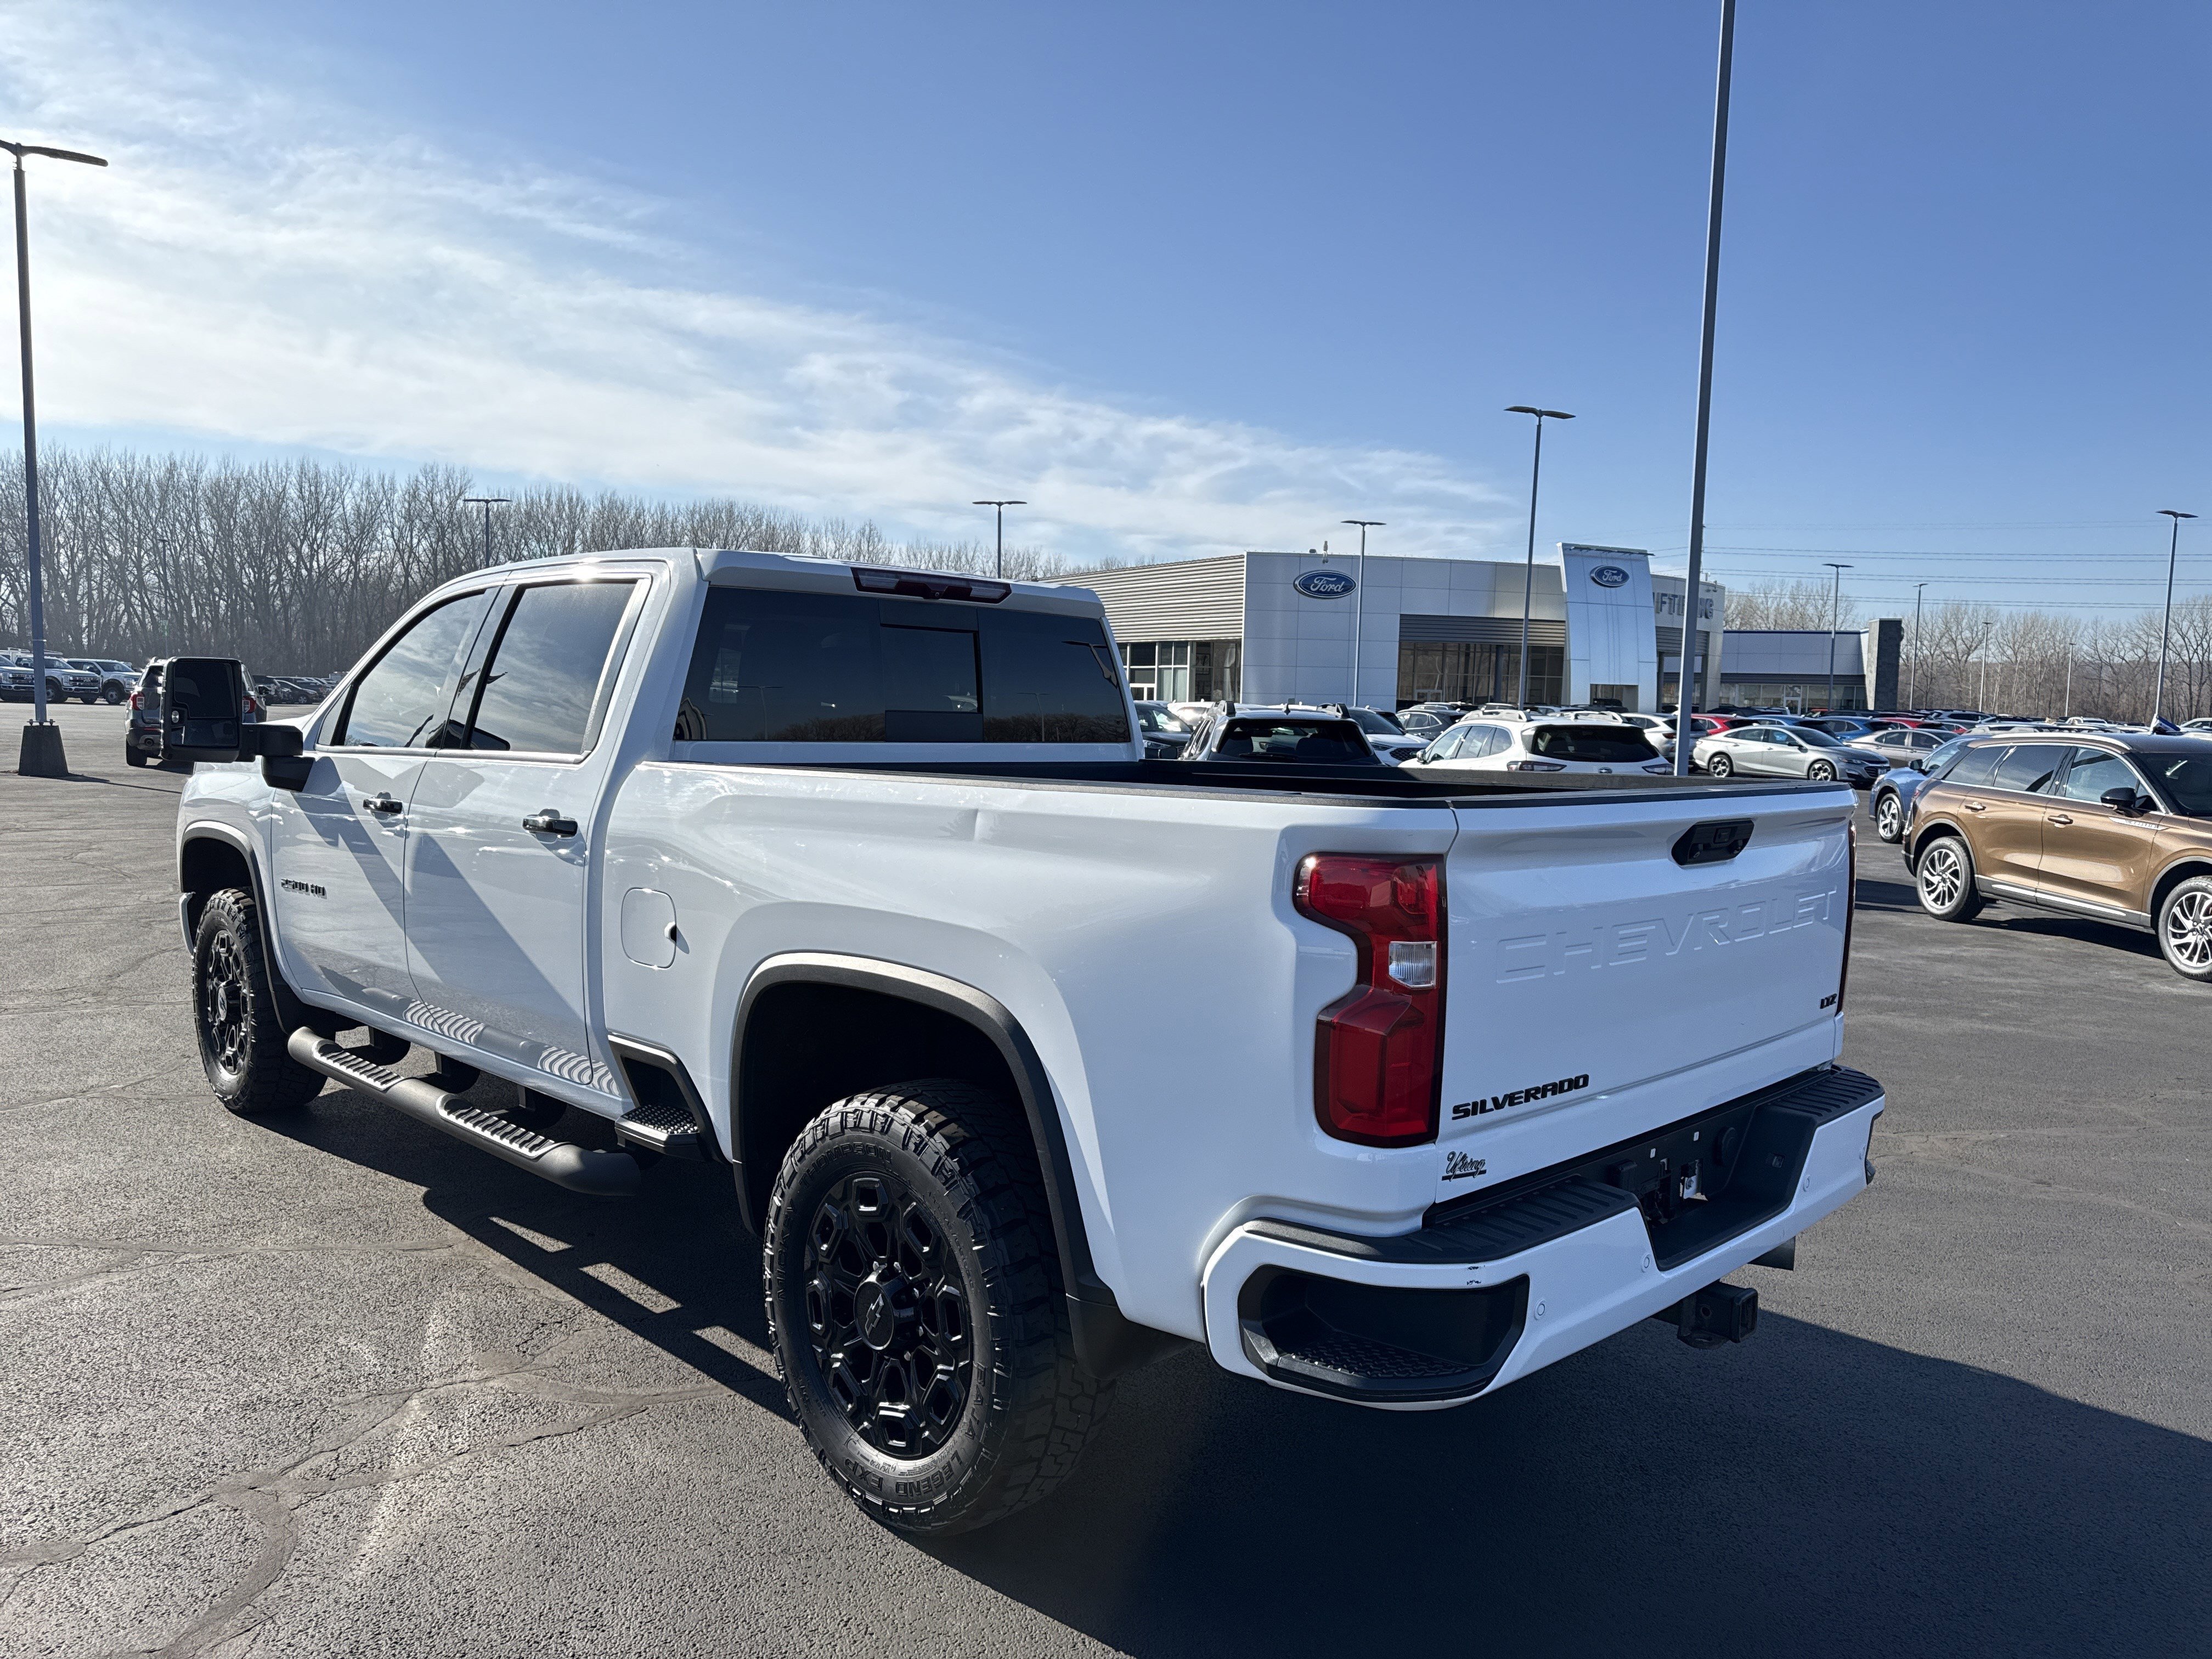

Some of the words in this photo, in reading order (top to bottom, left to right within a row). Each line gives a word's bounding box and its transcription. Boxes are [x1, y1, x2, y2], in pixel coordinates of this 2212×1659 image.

[1310, 577, 1344, 592] Ford
[1602, 569, 1623, 582] Ford
[1496, 885, 1837, 984] CHEVROLET
[1820, 994, 1837, 1009] LTZ
[1452, 1074, 1589, 1120] SILVERADO
[798, 1142, 893, 1187] THOMPSON
[964, 1362, 986, 1441] BAJA
[844, 1458, 883, 1492] EXP
[895, 1450, 963, 1498] LEGEND
